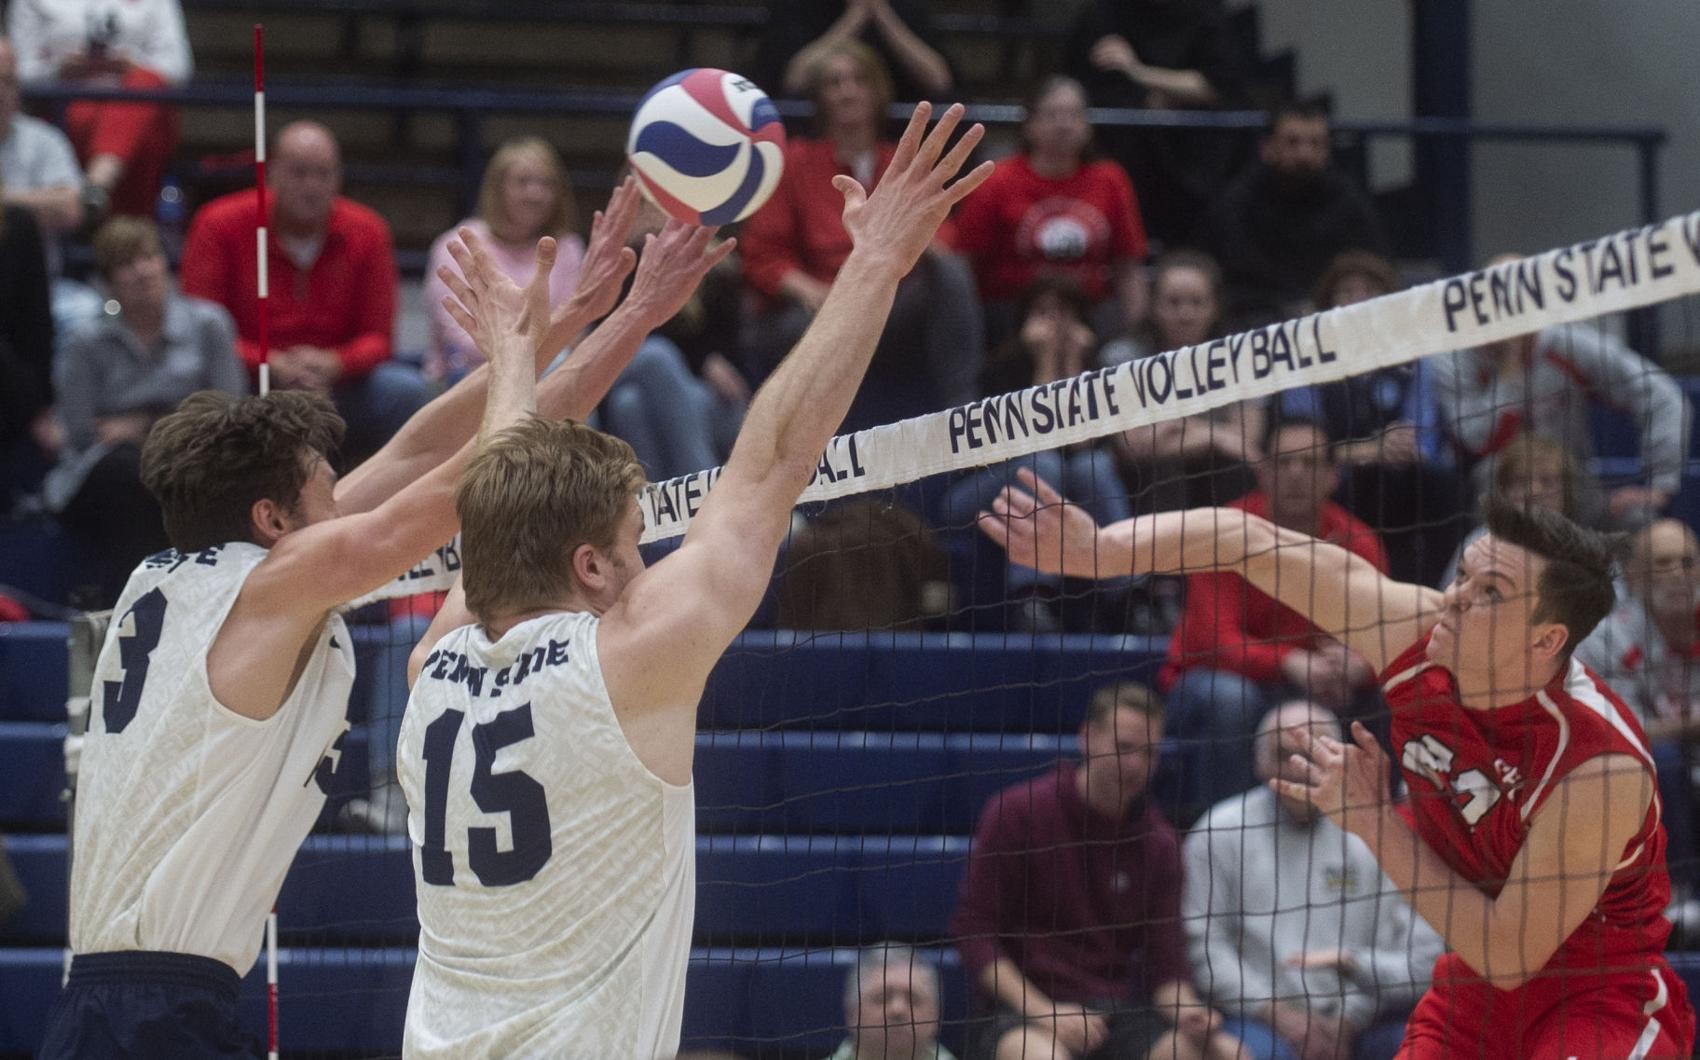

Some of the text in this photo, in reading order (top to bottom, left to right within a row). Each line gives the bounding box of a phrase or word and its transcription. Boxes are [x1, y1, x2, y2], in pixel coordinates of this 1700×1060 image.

[1443, 260, 1546, 332] PENN
[1553, 224, 1675, 302] STATE
[949, 313, 1337, 454] PENN STATE VOLLEYBALL
[638, 472, 702, 526] TATE
[421, 700, 553, 887] 15
